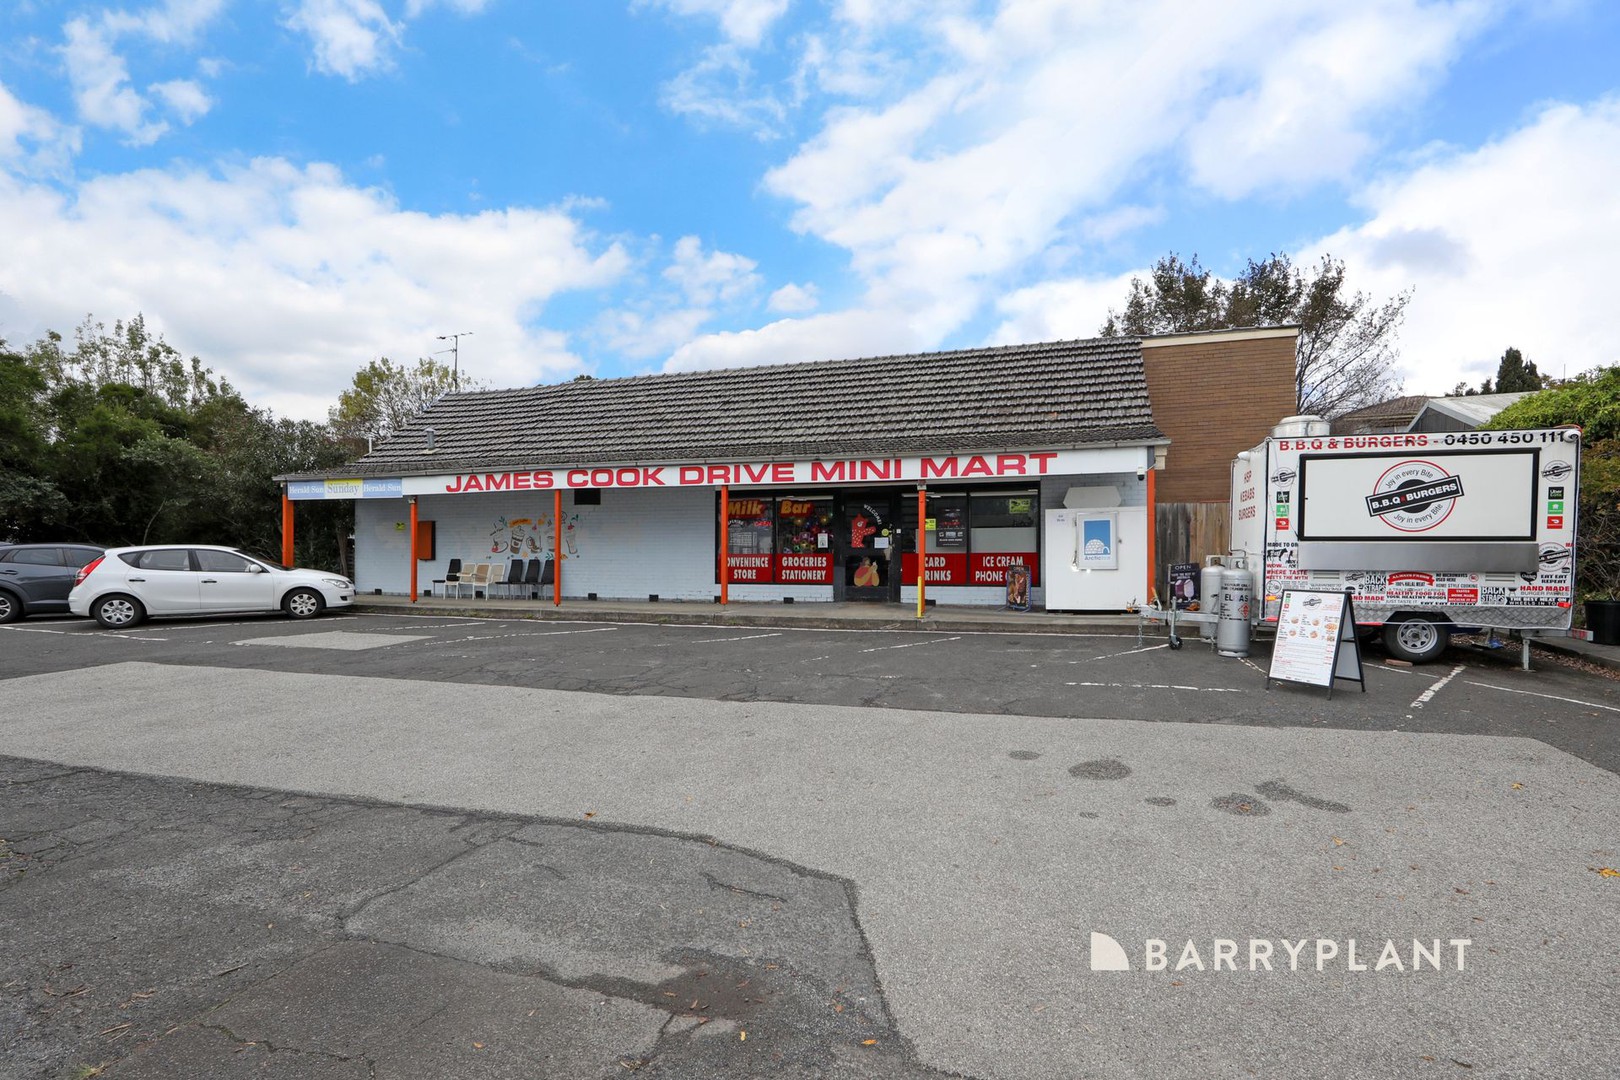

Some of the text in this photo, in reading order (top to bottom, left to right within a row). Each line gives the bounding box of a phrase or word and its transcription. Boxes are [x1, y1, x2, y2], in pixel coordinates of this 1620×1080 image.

[1279, 440, 1323, 451] B.B.Q
[1327, 439, 1339, 450] &
[1344, 434, 1428, 449] BURGERS
[1445, 433, 1492, 446] 0450
[1497, 432, 1534, 445] 450
[1540, 431, 1565, 443] 111
[446, 452, 1058, 493] JAMES COOK DRIVE MINI MART
[1385, 477, 1396, 489] Joy
[1402, 469, 1420, 477] every
[1420, 469, 1434, 479] Bite
[289, 485, 324, 494] Herald Sun
[326, 482, 359, 495] Sunday
[363, 482, 402, 492] Herald Sun
[1371, 483, 1457, 509] B.B.Q BURGERS
[728, 500, 811, 515] Milk Bar
[1393, 503, 1444, 524] Joy in every Bite
[728, 557, 769, 568] ONVENIENCE
[782, 556, 827, 568] GROCERIES
[982, 556, 1024, 567] ICE CREAM
[733, 569, 757, 580] STORE
[781, 569, 826, 581] STATIONERY
[925, 570, 952, 581] RINKS
[975, 570, 1003, 582] PHONE
[1365, 574, 1387, 585] BACK
[1482, 586, 1505, 594] BACK
[1481, 594, 1505, 602] STRAPS
